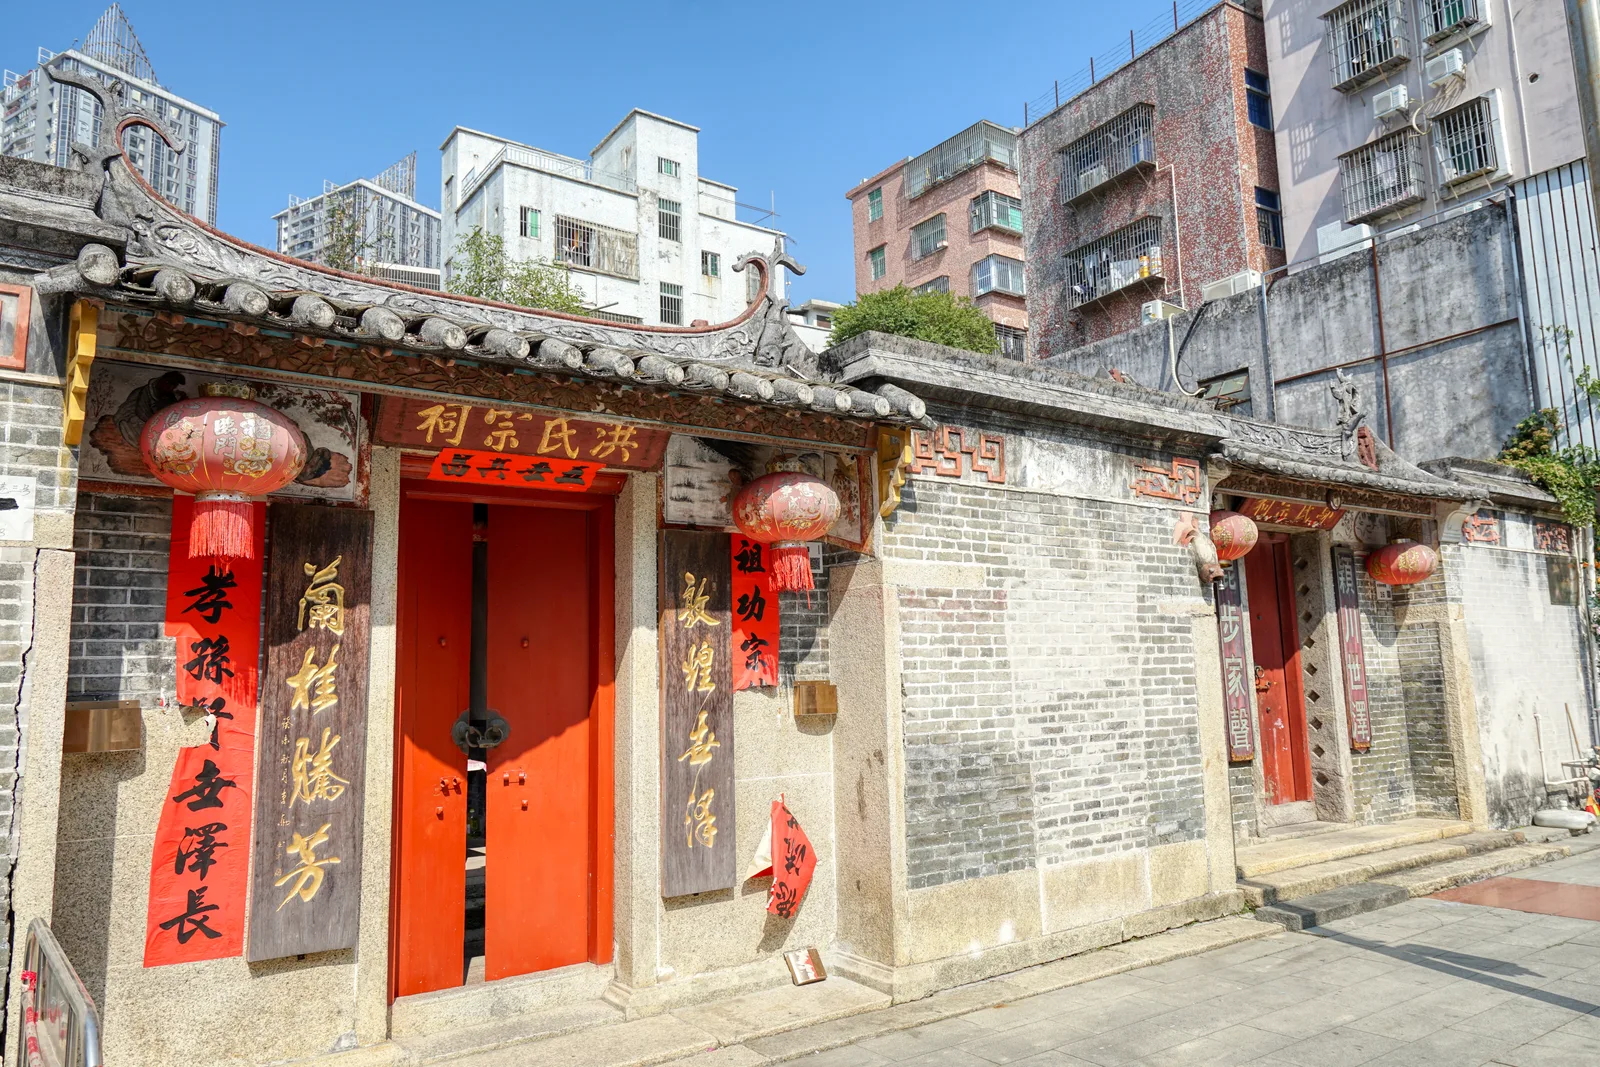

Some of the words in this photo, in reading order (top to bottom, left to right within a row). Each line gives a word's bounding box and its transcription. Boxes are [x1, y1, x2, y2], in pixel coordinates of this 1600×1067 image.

[417, 403, 638, 463] 洪氏宗祠
[441, 453, 590, 487] 五世其昌
[734, 539, 769, 688] 祖功宗
